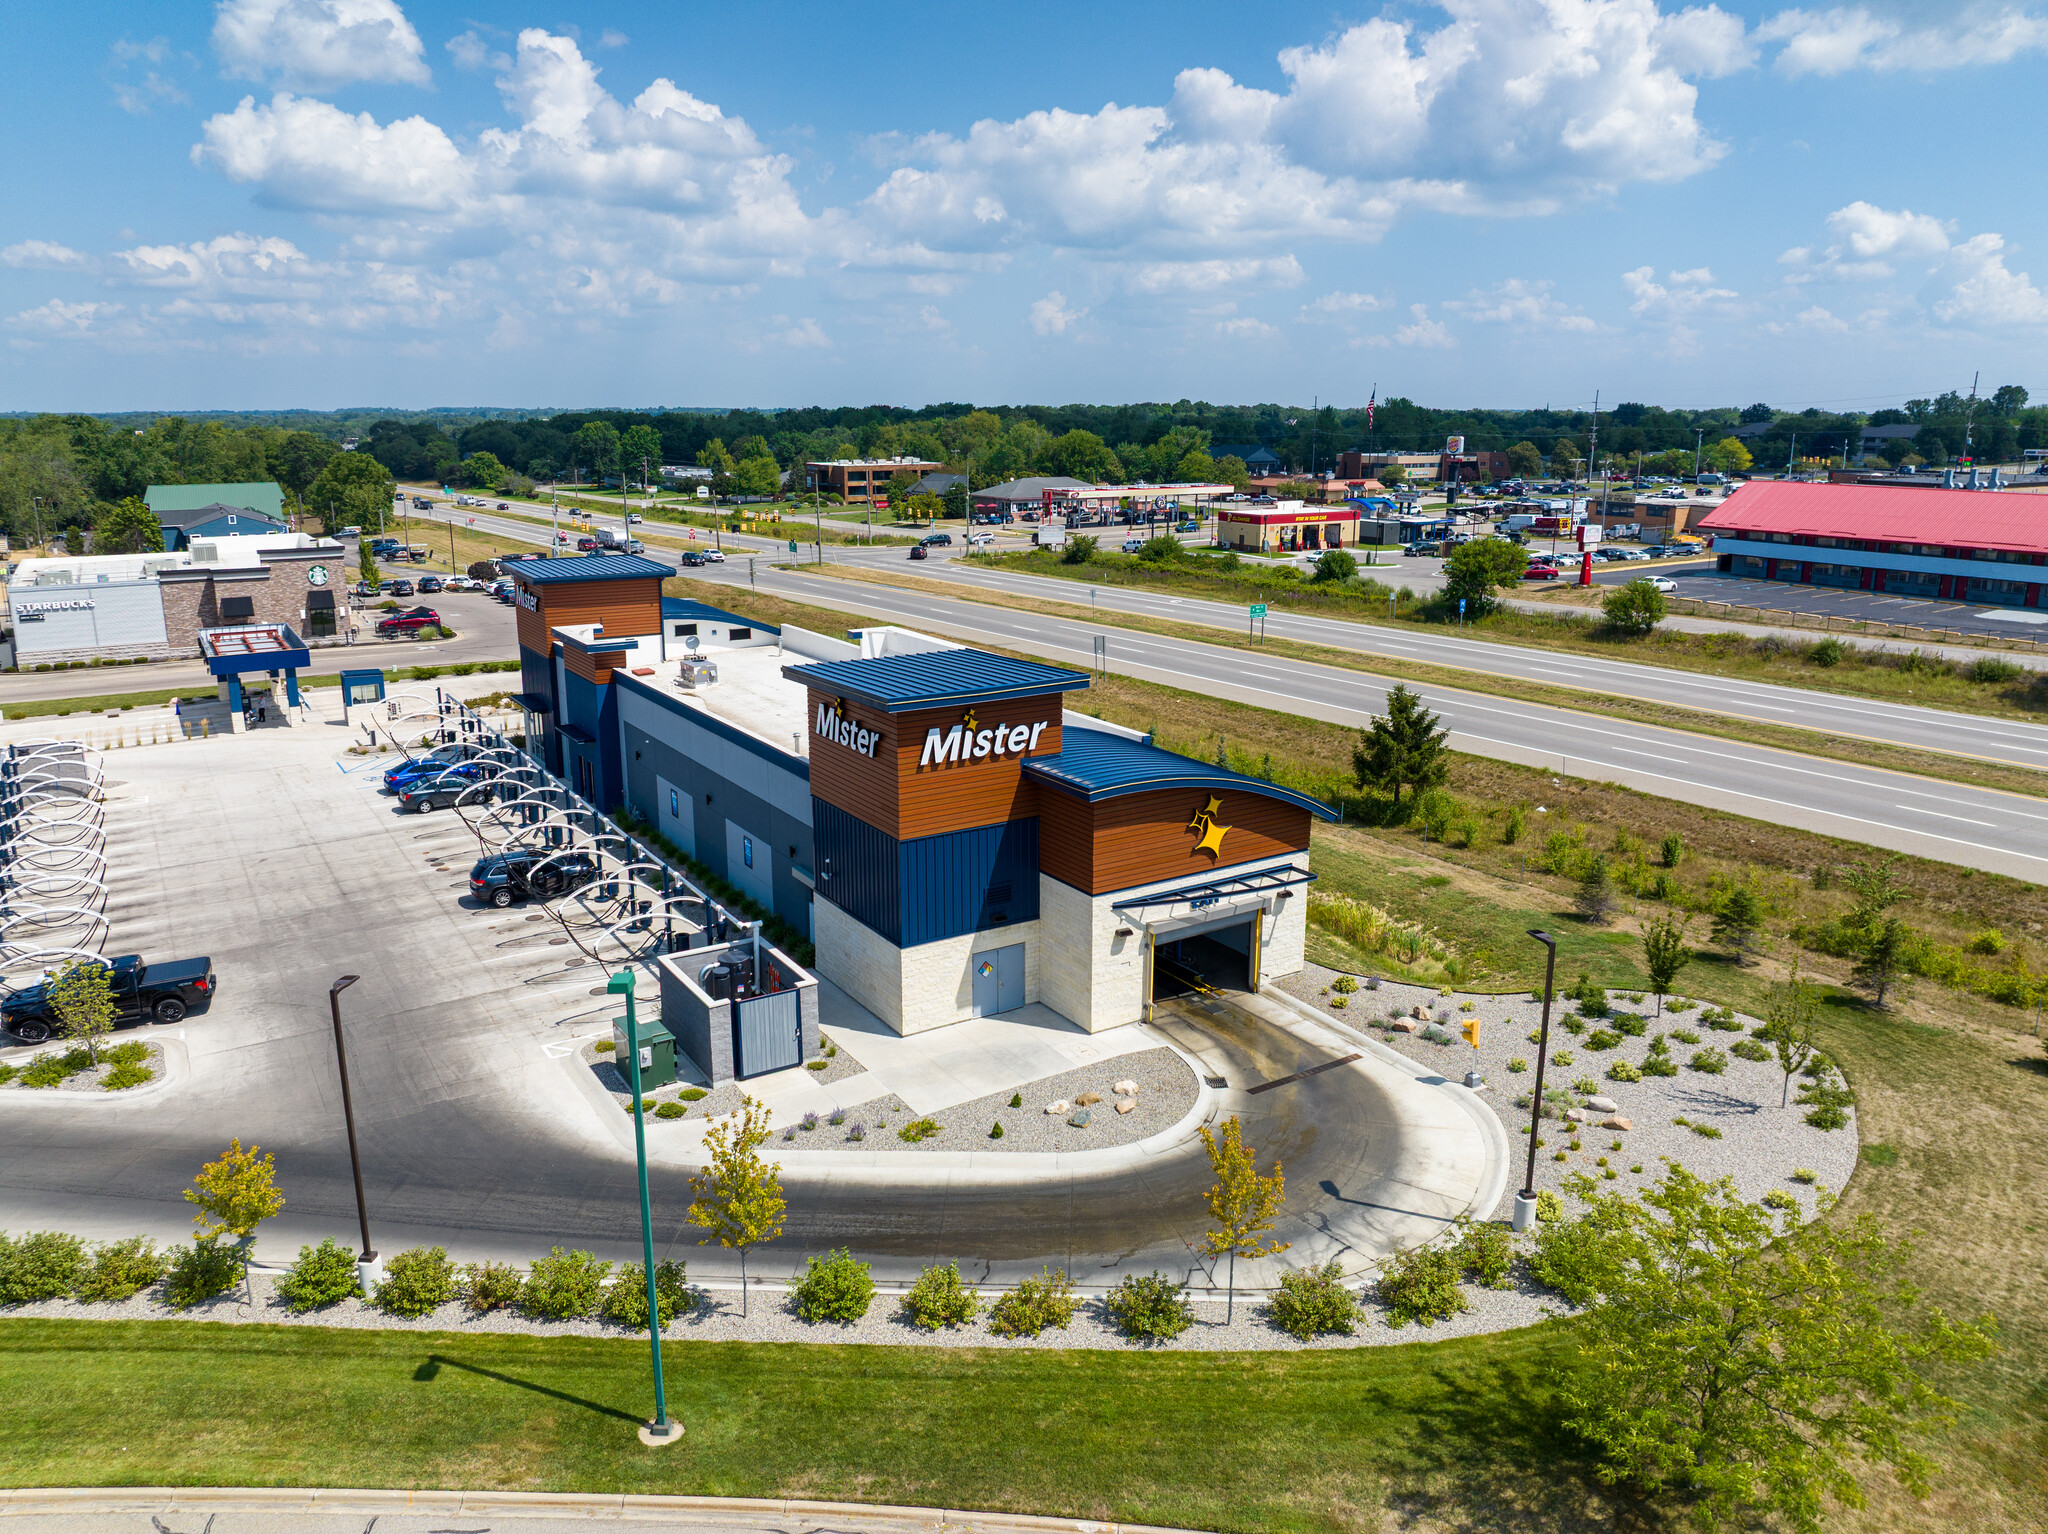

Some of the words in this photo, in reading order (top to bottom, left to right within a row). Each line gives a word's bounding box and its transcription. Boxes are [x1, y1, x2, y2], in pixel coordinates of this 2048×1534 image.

[16, 599, 96, 613] STARBUCKS
[516, 584, 538, 613] Mister
[815, 702, 881, 759] Mister
[919, 719, 1049, 767] Mister
